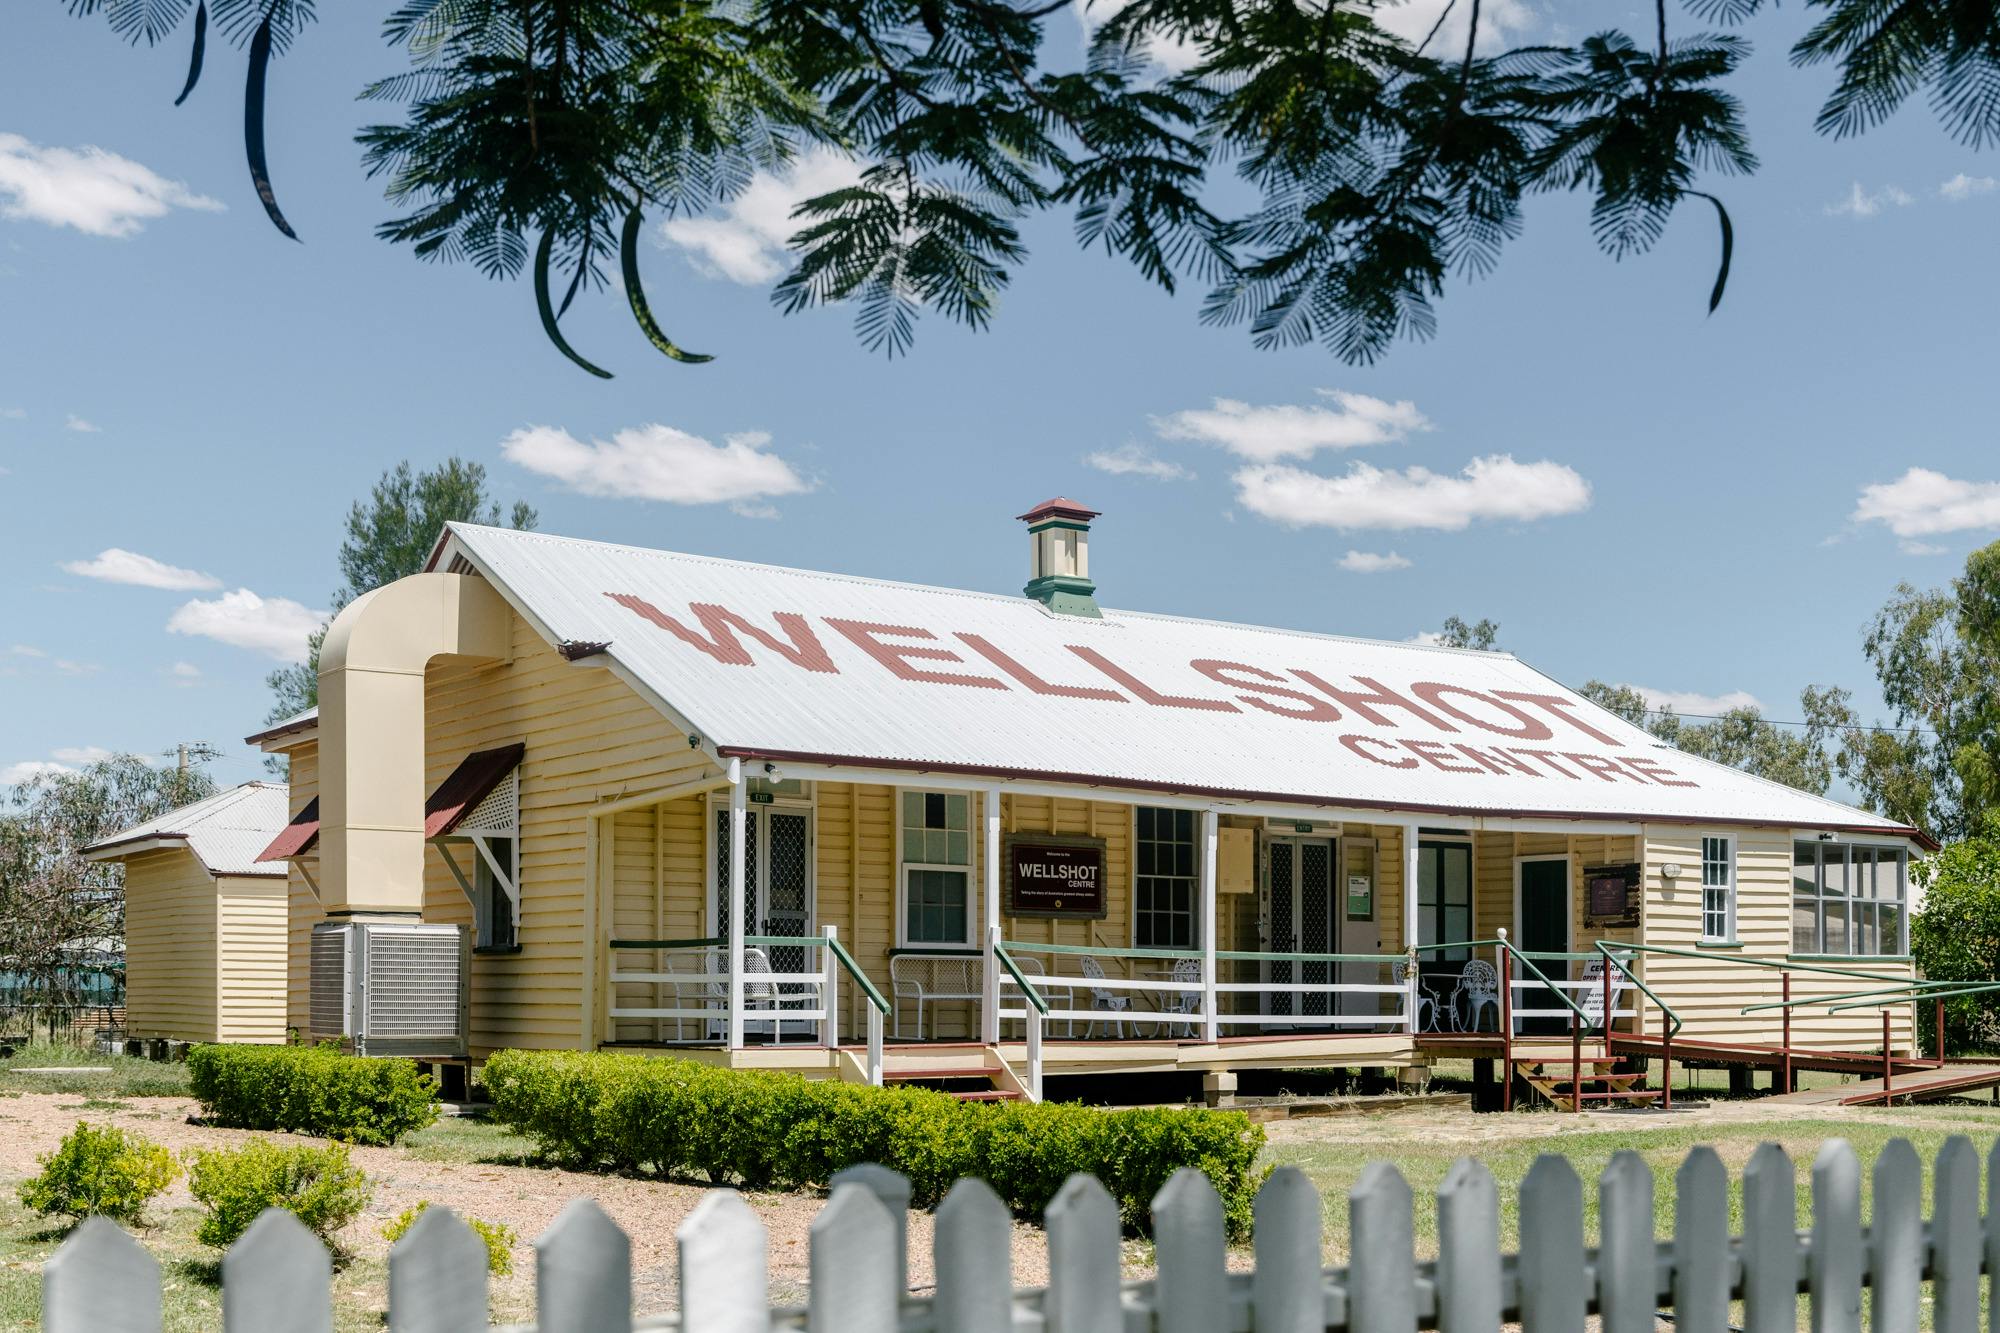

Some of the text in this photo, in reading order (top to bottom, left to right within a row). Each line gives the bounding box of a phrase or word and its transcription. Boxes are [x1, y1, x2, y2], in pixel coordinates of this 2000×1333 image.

[603, 591, 1625, 748] WELLSHOT
[1338, 734, 1700, 788] CENTRE
[755, 794, 769, 802] EXIT
[1019, 863, 1097, 880] WELLSHOT
[1068, 880, 1095, 888] CENTRE
